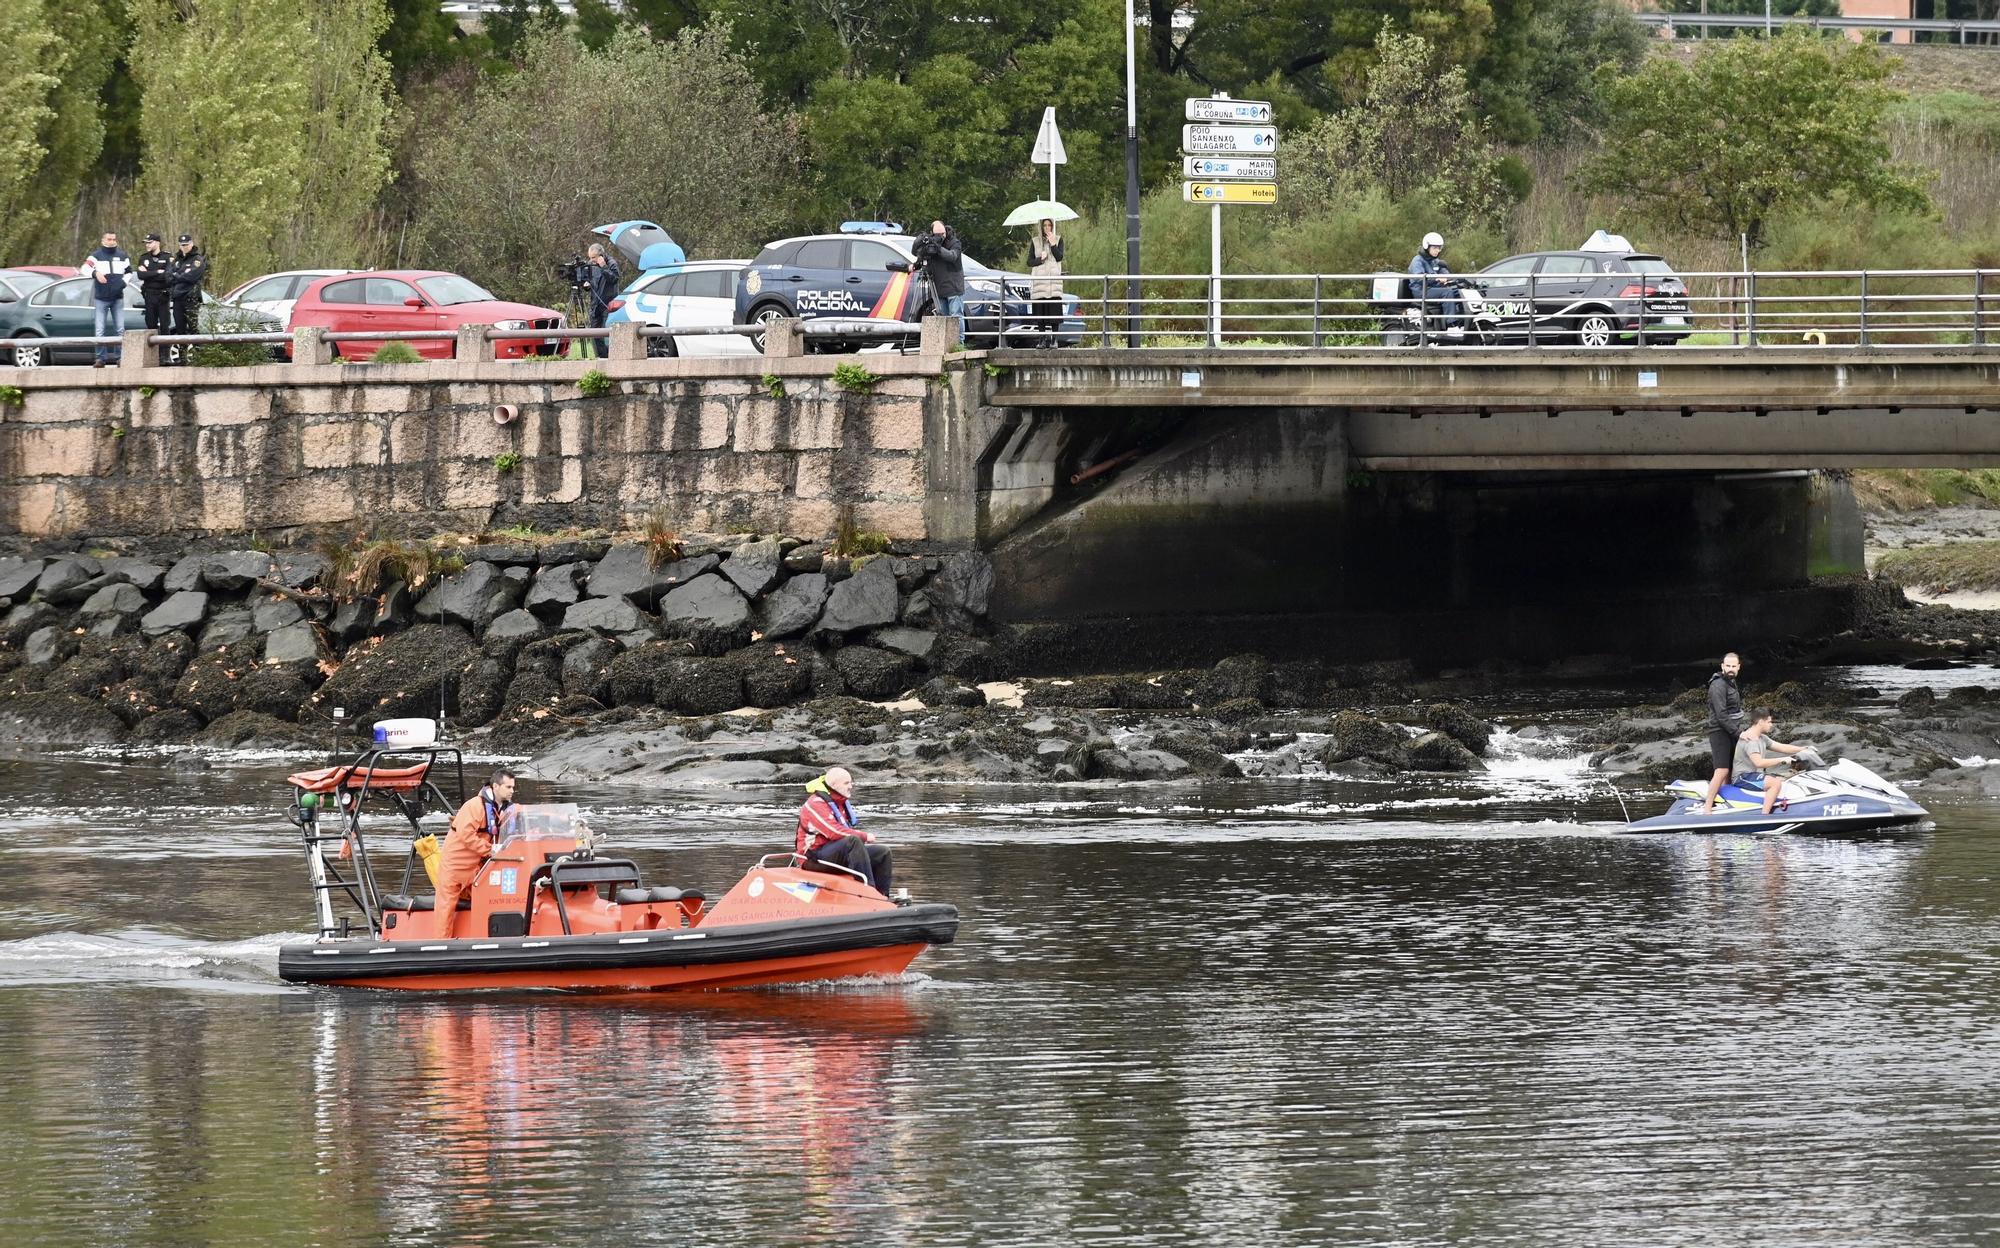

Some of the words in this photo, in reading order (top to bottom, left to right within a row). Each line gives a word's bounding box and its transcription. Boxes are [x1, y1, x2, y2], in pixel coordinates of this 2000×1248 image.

[1192, 142, 1237, 150] VILAGARCÍA
[1237, 168, 1273, 176] OURENSE
[1252, 189, 1275, 197] Hoteis
[797, 290, 853, 301] POLICÍA
[797, 301, 871, 311] NACIONAL
[385, 728, 409, 736] arine
